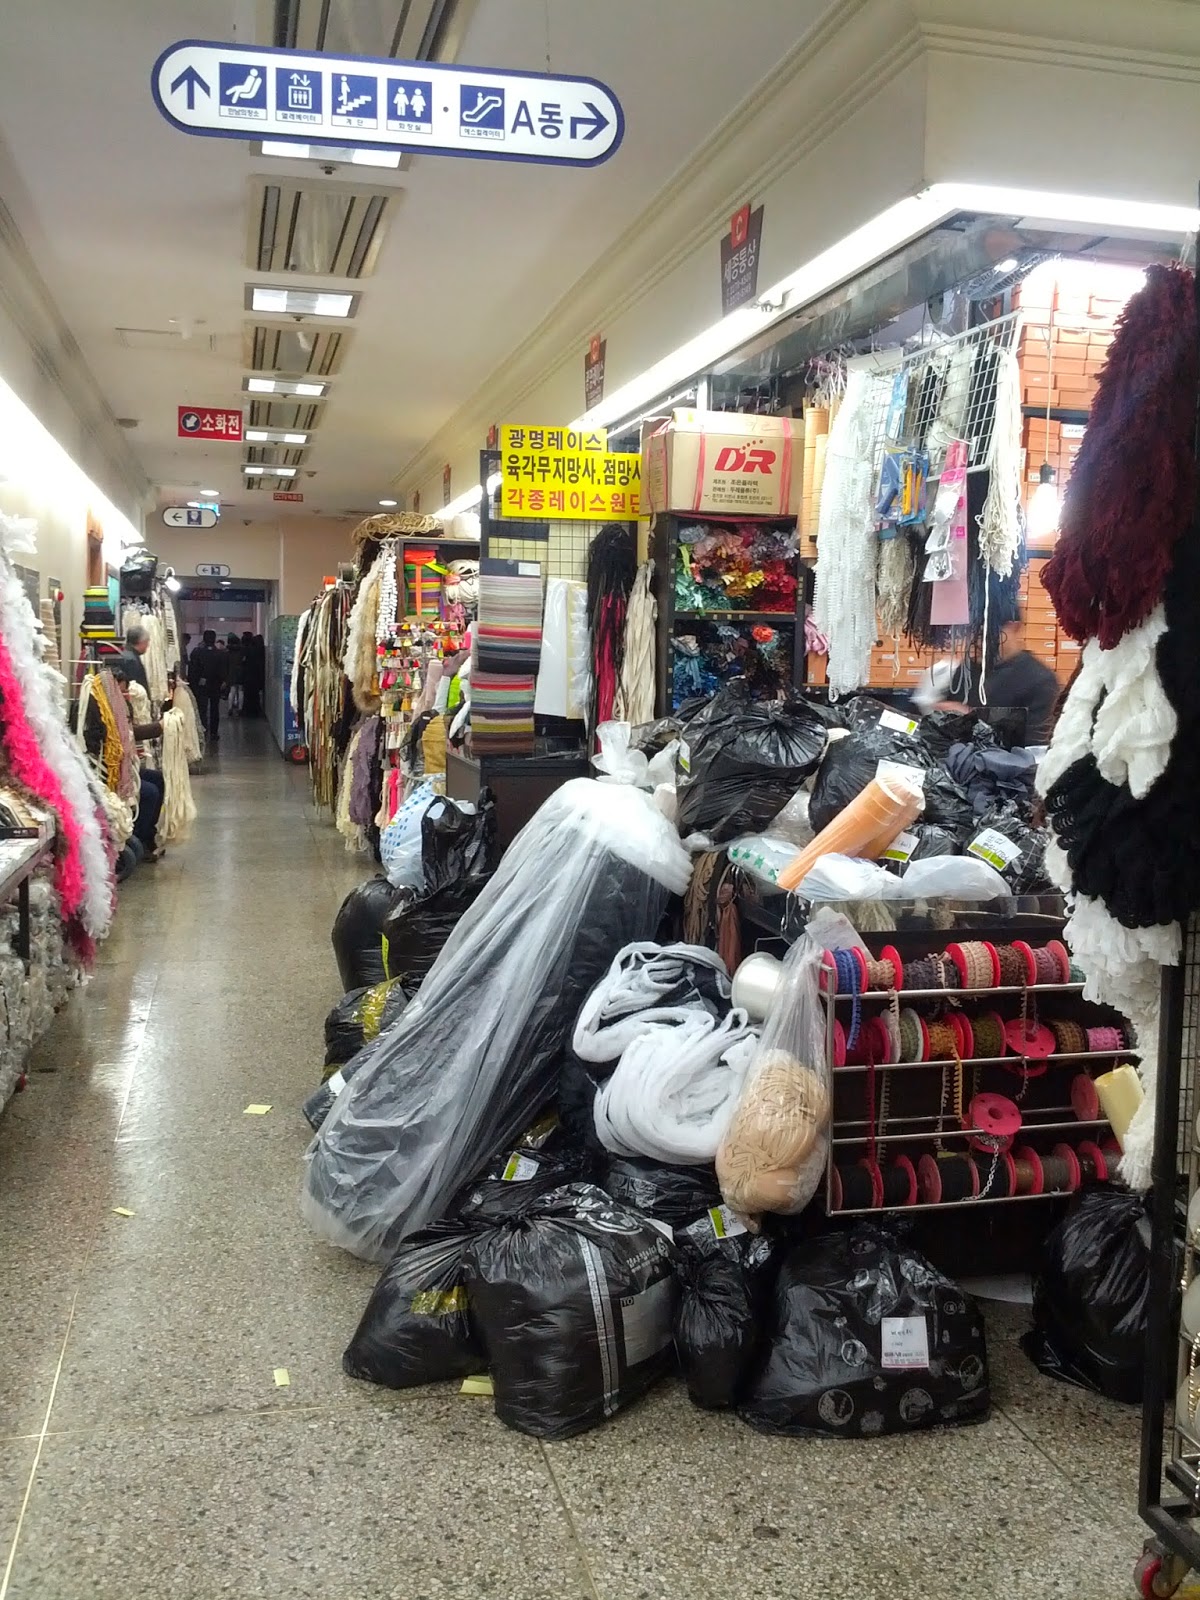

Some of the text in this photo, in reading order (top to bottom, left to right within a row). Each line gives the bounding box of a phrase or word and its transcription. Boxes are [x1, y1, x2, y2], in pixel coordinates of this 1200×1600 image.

[399, 122, 422, 131] 화장실
[511, 99, 564, 139] A동
[201, 413, 240, 436] 소화전
[508, 428, 603, 452] 광명레이스
